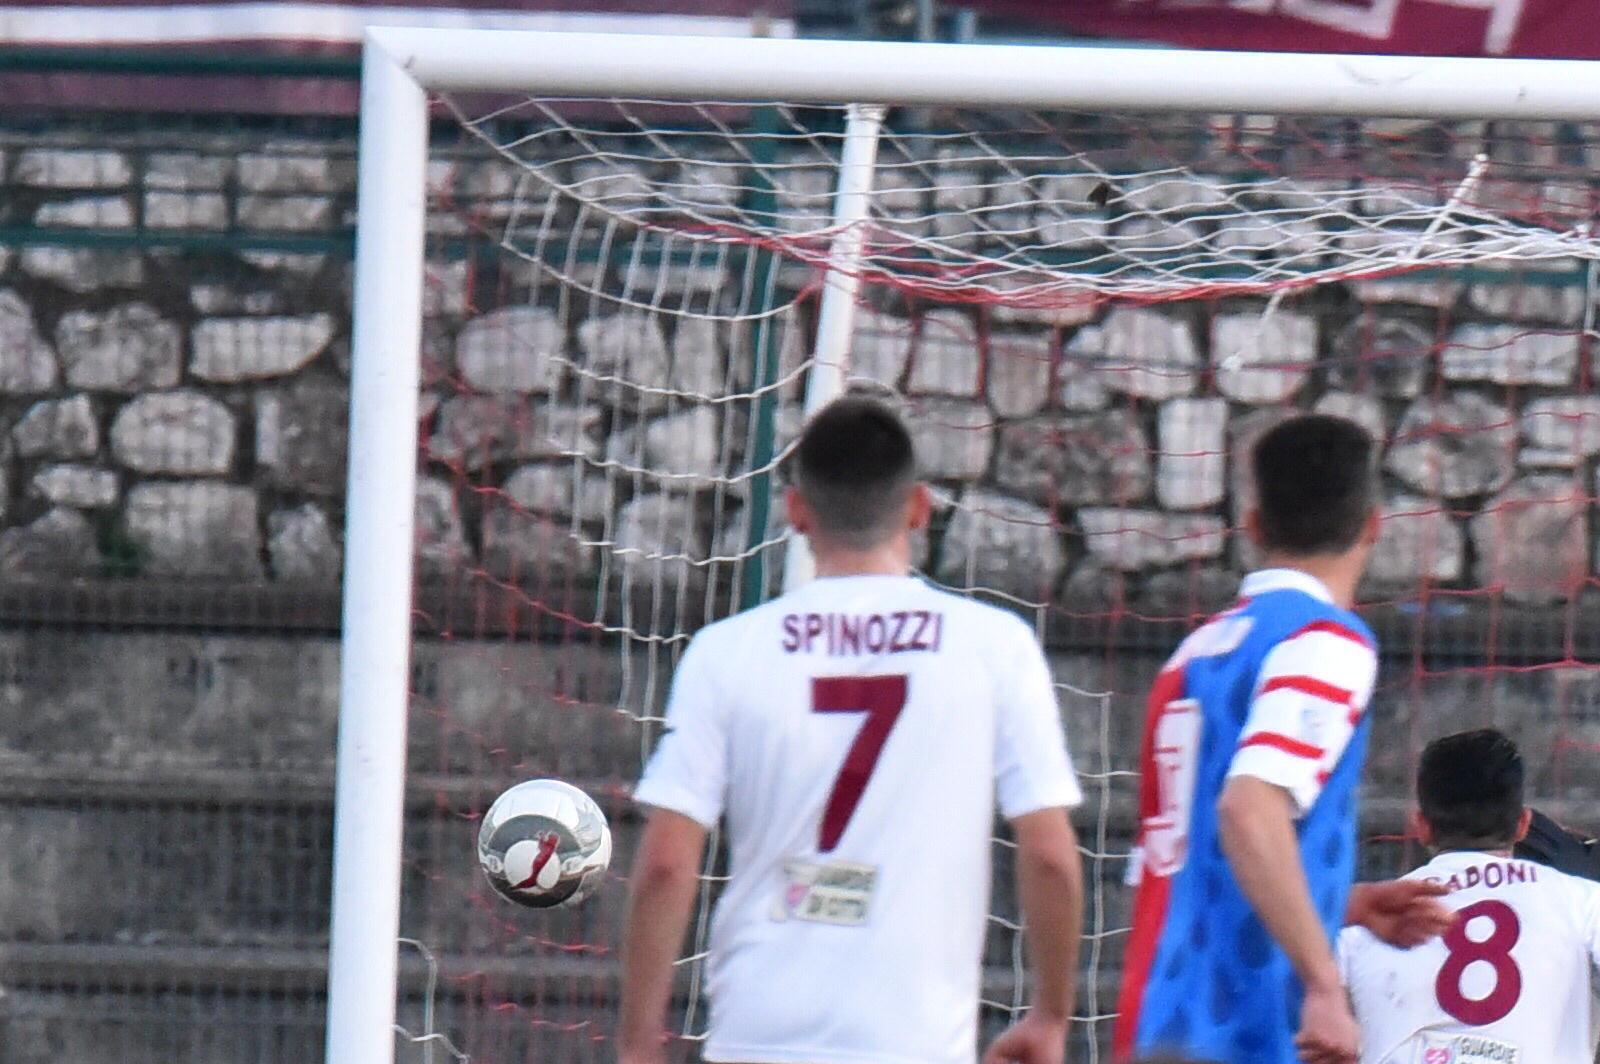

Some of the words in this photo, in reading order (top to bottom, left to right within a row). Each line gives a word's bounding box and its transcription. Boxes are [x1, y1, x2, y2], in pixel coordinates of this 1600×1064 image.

[783, 611, 942, 655] SPINOZZI
[810, 674, 909, 853] 7
[1425, 862, 1537, 892] ADONI
[1435, 899, 1521, 1026] 8
